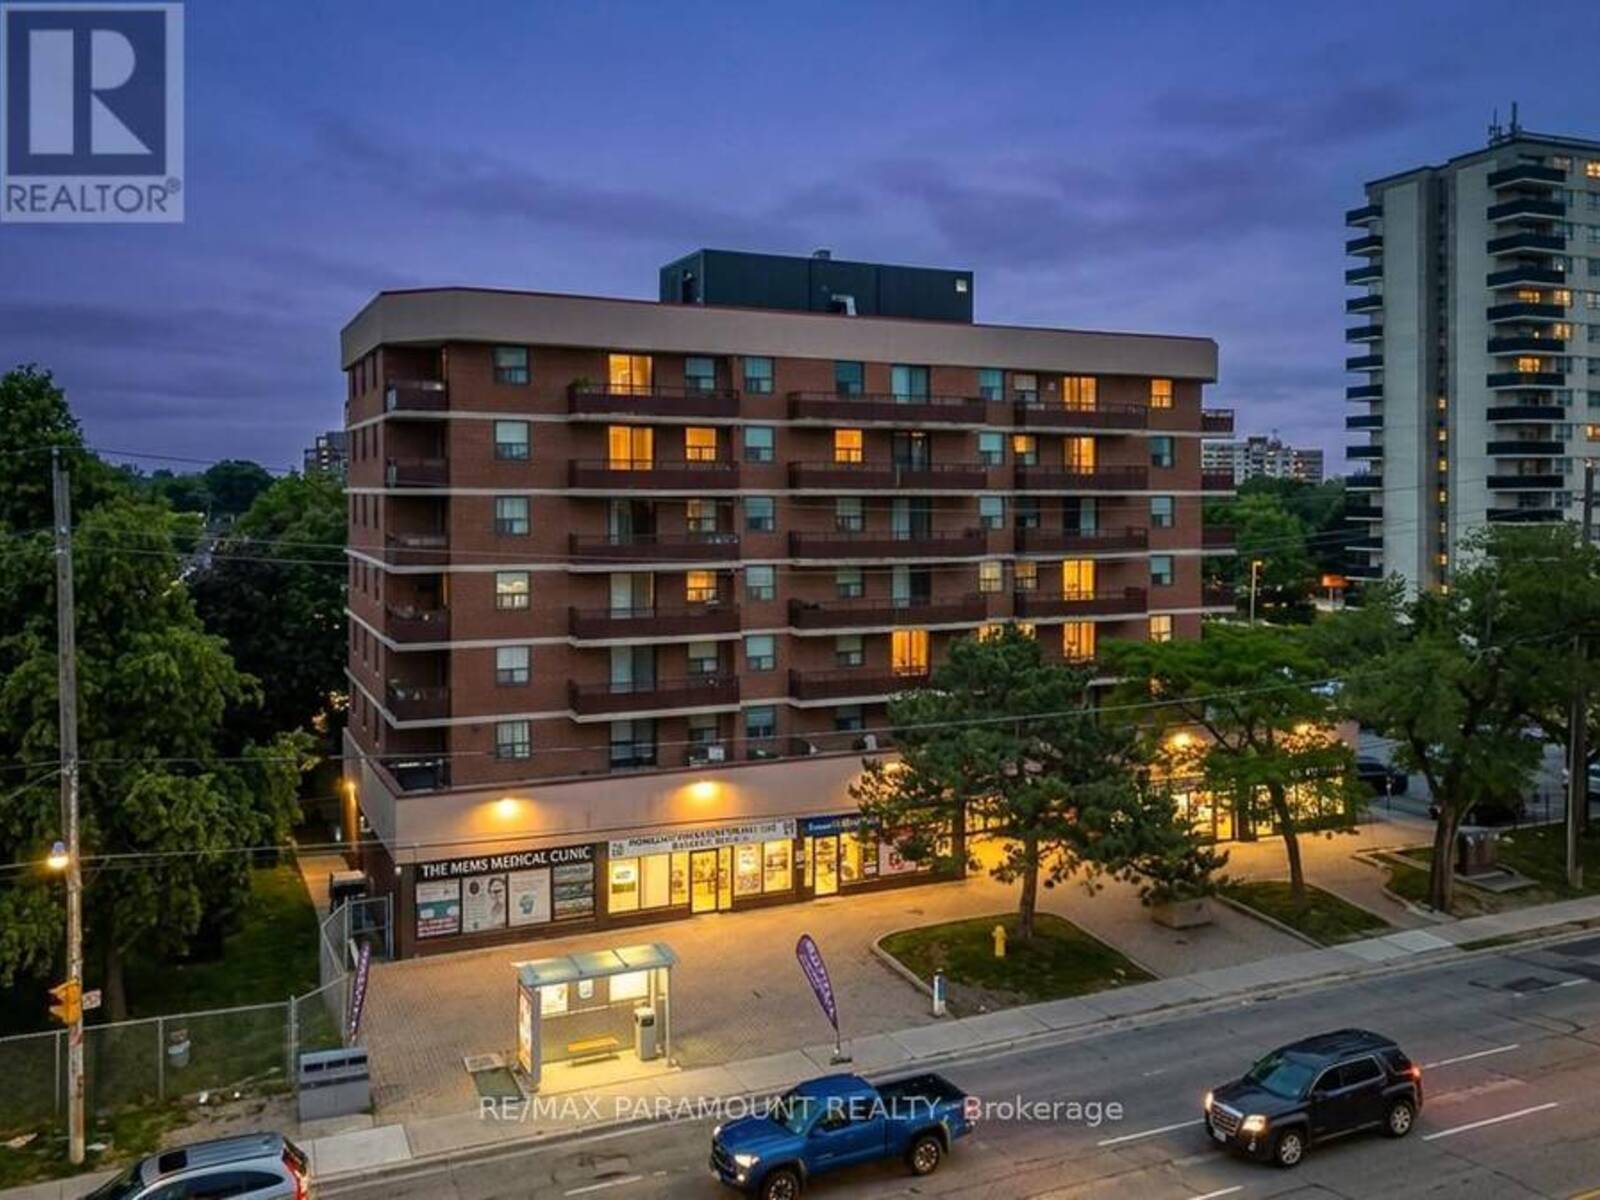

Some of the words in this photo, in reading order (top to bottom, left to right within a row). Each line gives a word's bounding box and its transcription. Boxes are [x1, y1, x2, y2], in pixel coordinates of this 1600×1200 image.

[422, 863, 447, 877] THE
[450, 859, 487, 874] MEMS
[490, 852, 548, 870] MEDICAL
[550, 847, 591, 863] CLINIC
